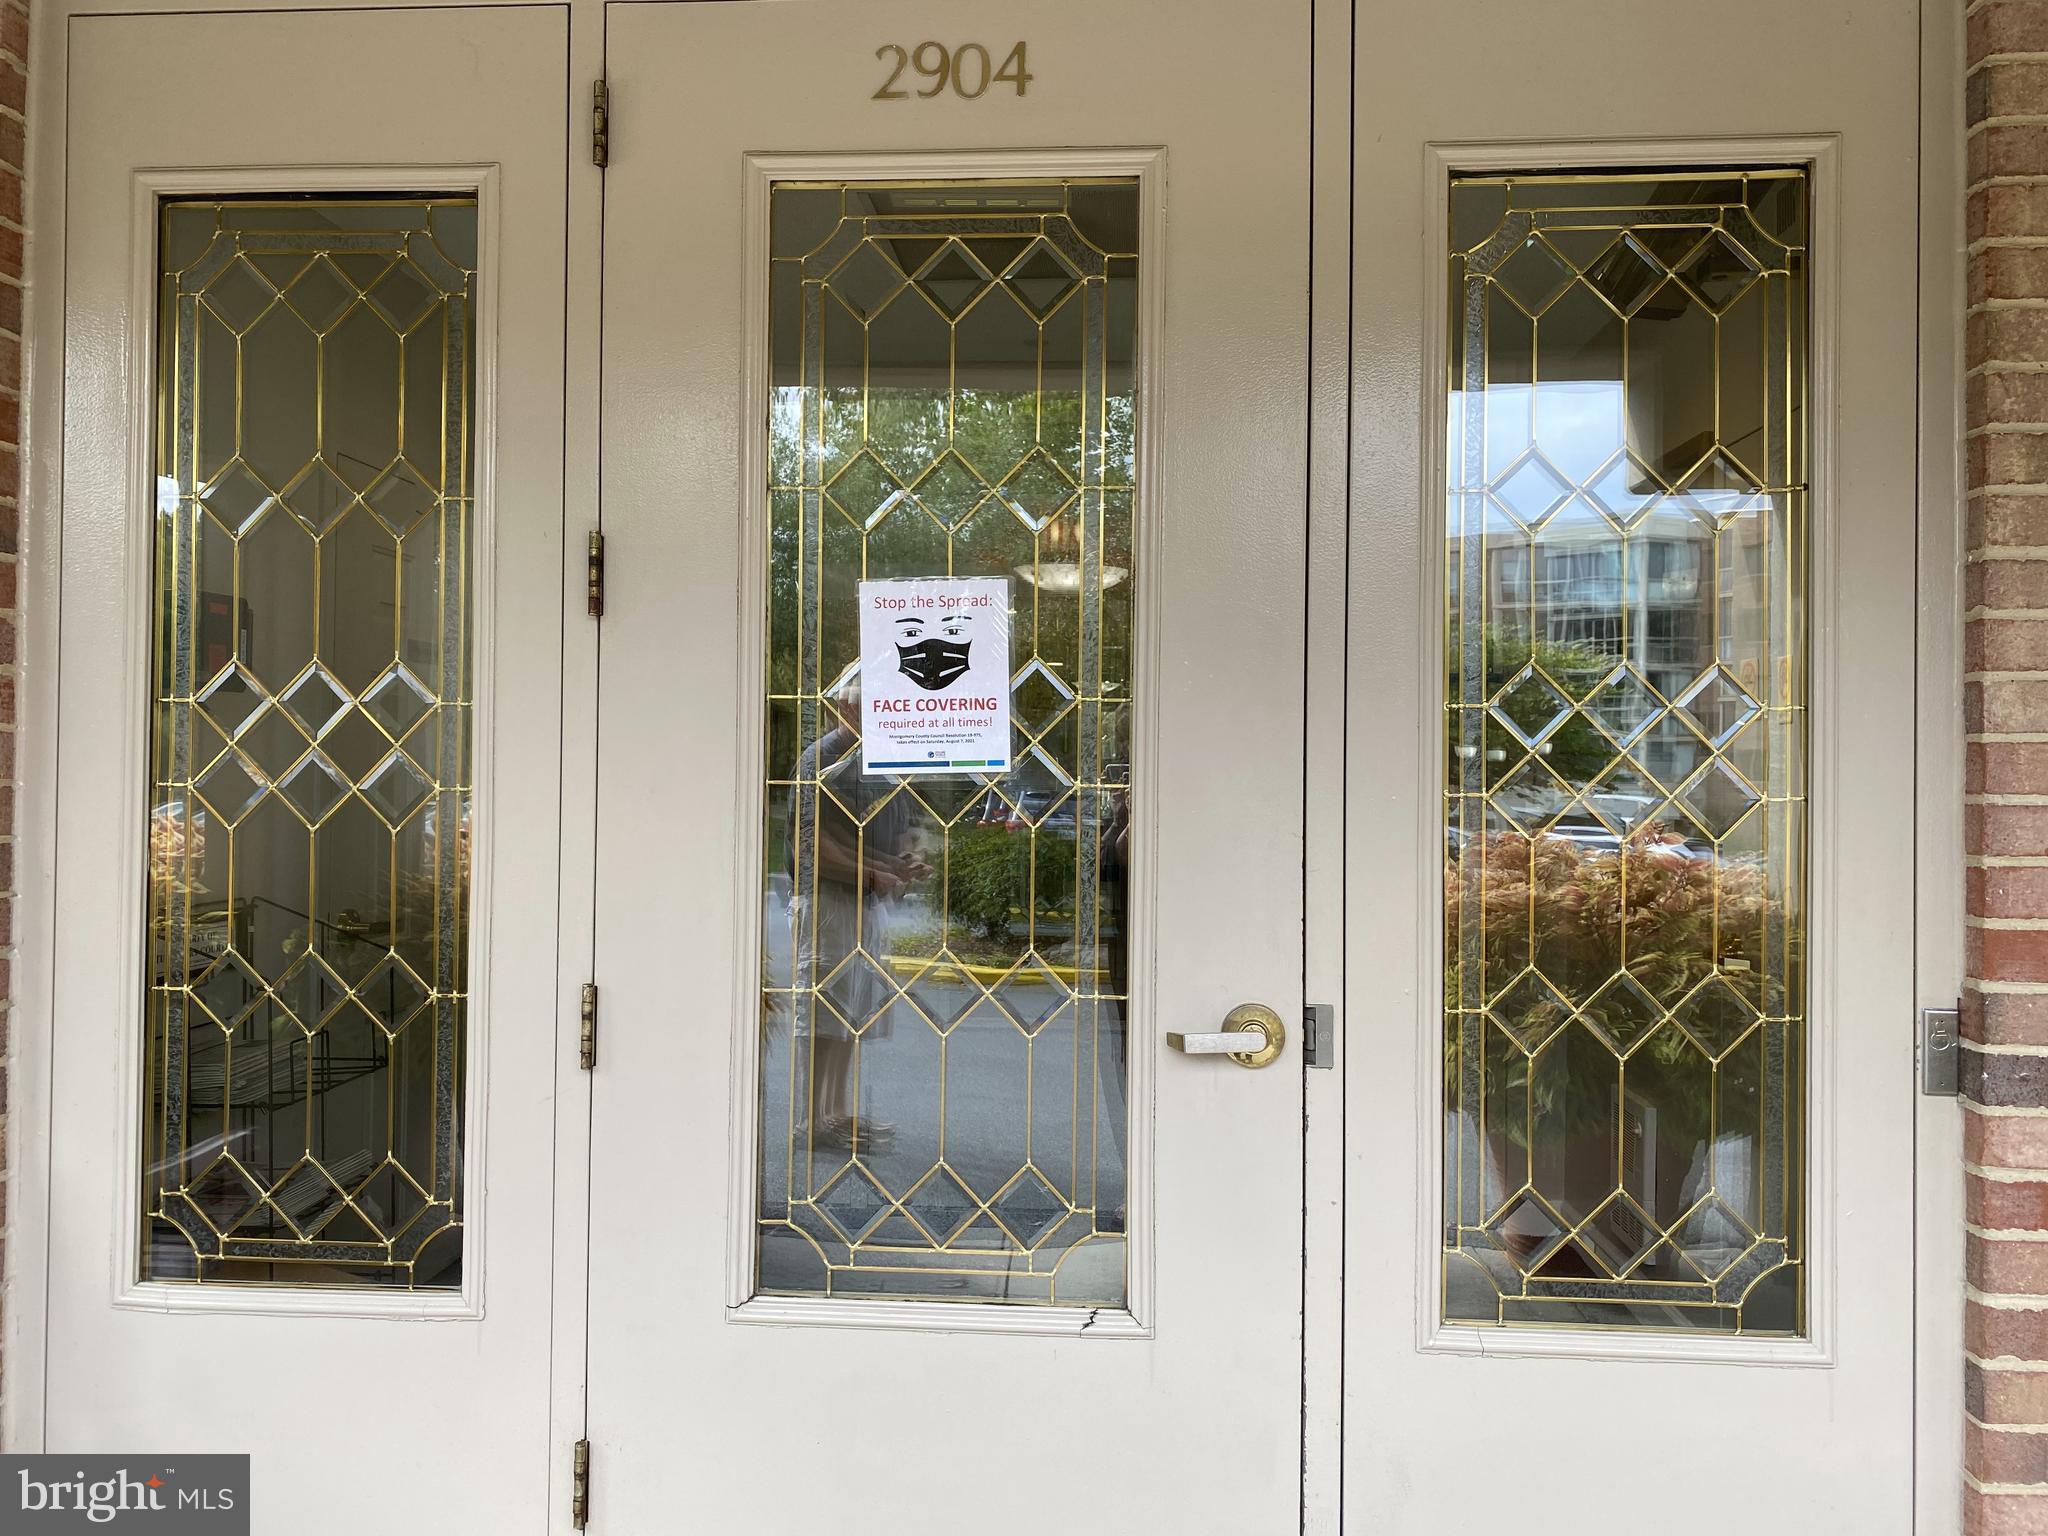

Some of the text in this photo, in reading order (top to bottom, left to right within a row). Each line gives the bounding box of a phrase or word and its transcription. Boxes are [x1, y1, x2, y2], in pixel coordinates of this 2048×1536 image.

[871, 41, 1034, 99] 2904
[874, 594, 993, 611] Stop the Spread:
[873, 697, 997, 713] FACE COVERING
[878, 716, 993, 730] required at all times!
